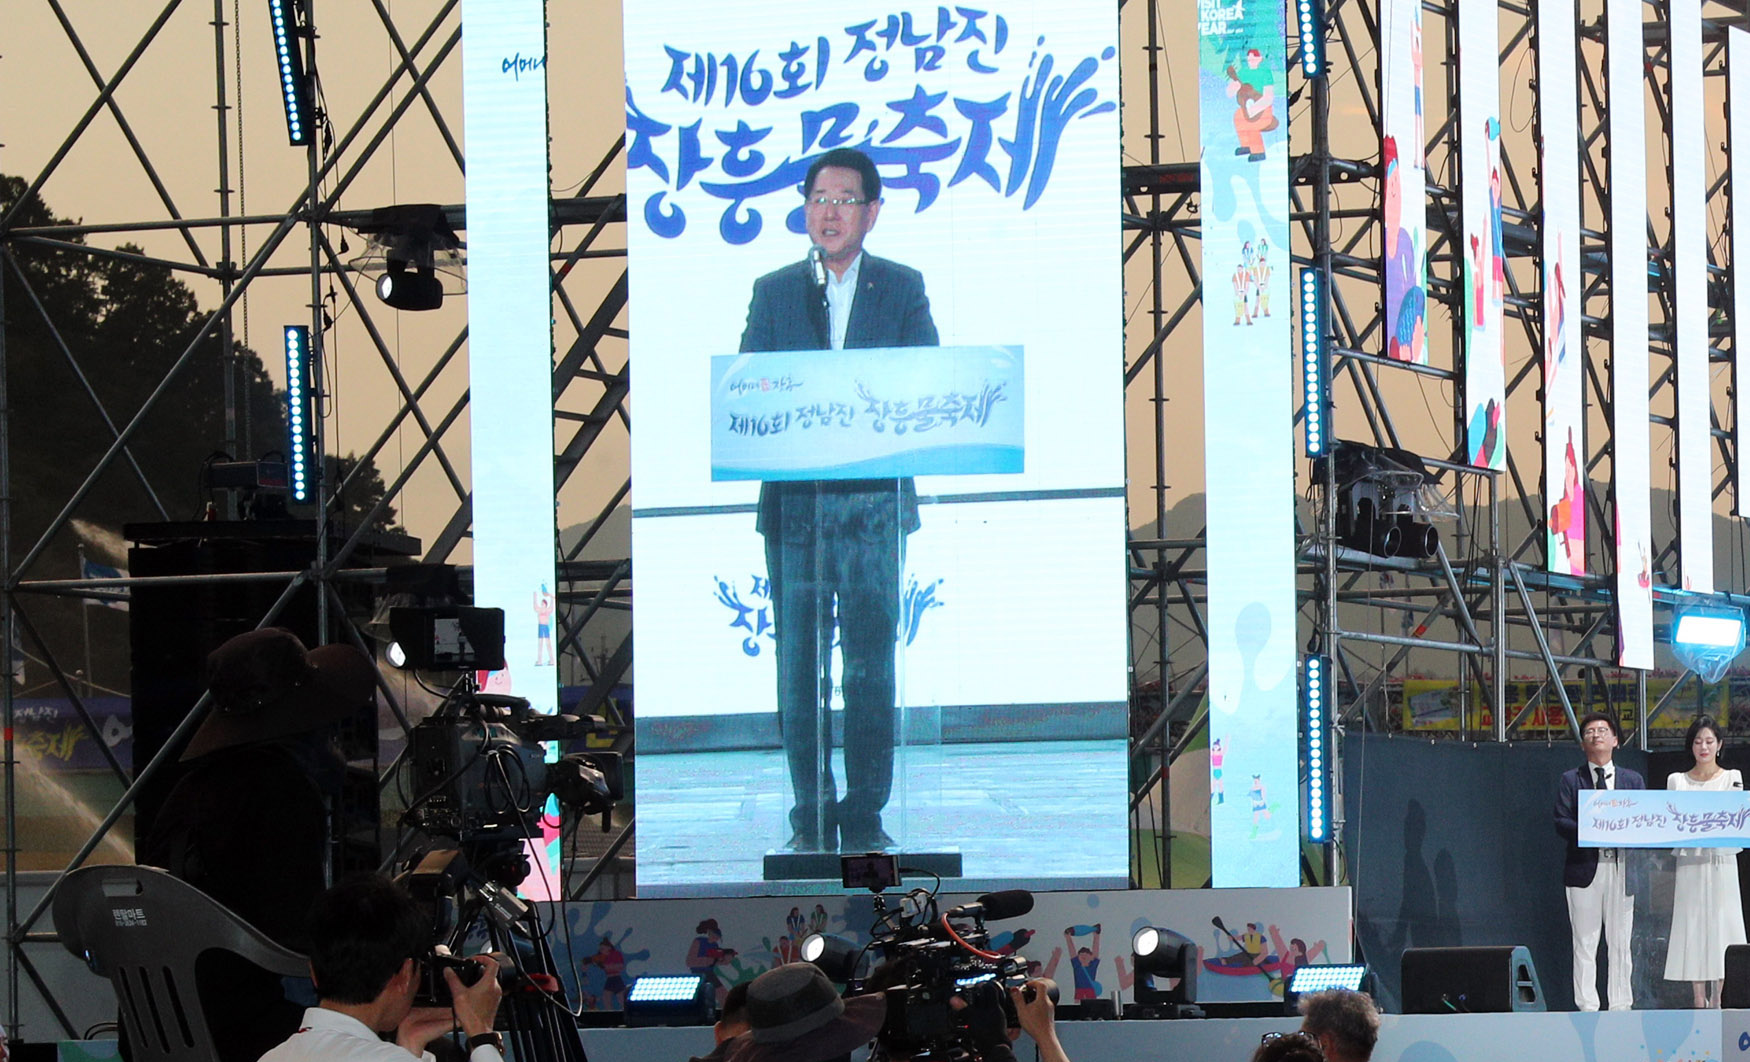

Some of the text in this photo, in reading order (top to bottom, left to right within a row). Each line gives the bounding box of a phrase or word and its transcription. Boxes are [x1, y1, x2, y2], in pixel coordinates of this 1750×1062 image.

[1200, 6, 1244, 21] KOREA
[1197, 22, 1227, 36] EAR
[661, 6, 1009, 108] 제16회 정남진
[728, 411, 789, 437] 제16회
[795, 403, 855, 429] 정남진
[1592, 817, 1630, 832] 제16회
[1631, 812, 1667, 829] 정남진
